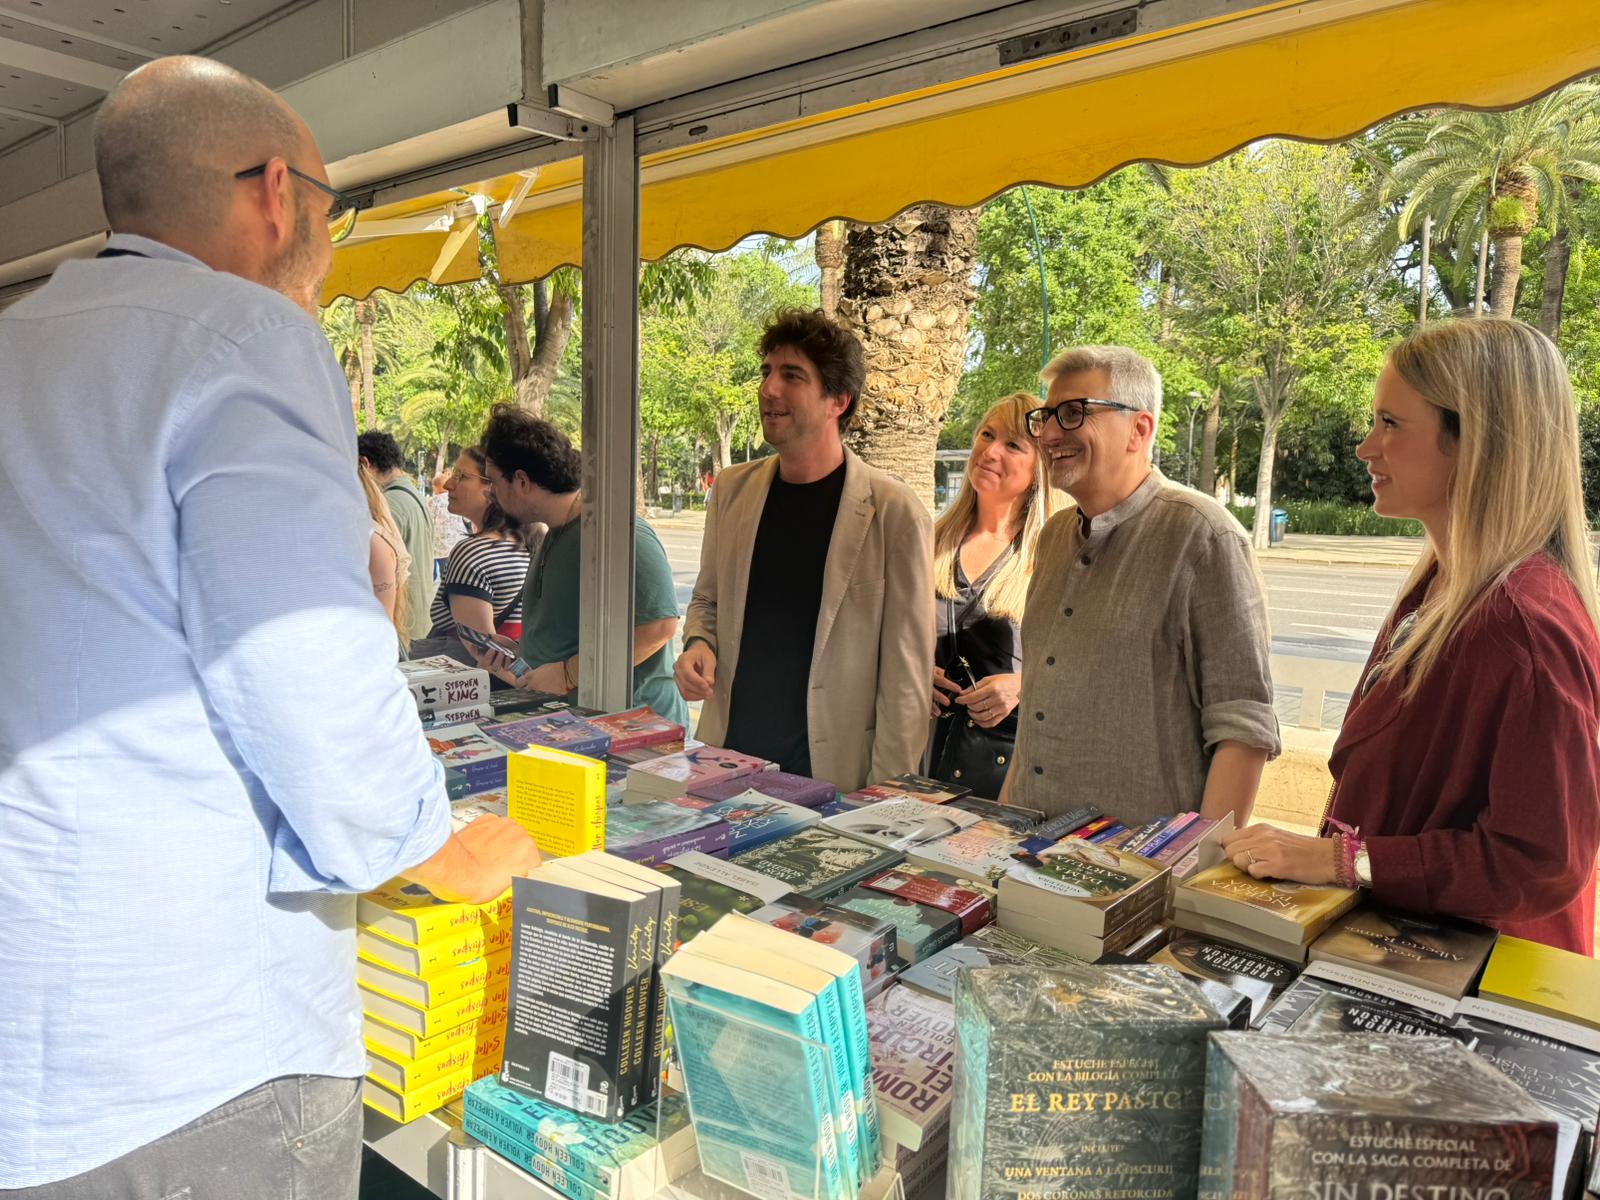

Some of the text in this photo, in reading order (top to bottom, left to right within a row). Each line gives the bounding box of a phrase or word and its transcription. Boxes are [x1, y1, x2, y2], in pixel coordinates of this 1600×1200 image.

[422, 685, 437, 704] IT
[445, 678, 479, 691] STEPHEN
[447, 689, 479, 704] KING
[445, 709, 480, 722] STEPHEN
[1056, 866, 1102, 884] DAMA
[1058, 856, 1127, 880] CARTUJA
[1062, 875, 1081, 884] LA
[1208, 879, 1298, 910] INGRATA
[1201, 946, 1284, 976] SANDERSON
[1400, 941, 1464, 961] Alberto
[1203, 955, 1269, 979] BRANDON
[633, 915, 657, 1066] COLLEEN HOOVER Verity
[654, 911, 678, 1058] COLLEEN HOOV Verity
[849, 975, 860, 1016] EMPEZAR
[1318, 966, 1446, 1006] BRANDON SANDERSON
[1340, 986, 1396, 1006] BRANDON
[620, 924, 642, 1076] COLLEEN HOOVER Verity
[825, 990, 839, 1036] EMPEZAR
[890, 1005, 955, 1038] OOVER
[1348, 1008, 1438, 1038] ANDERSON
[896, 1020, 954, 1045] COLLEEN
[1353, 1018, 1411, 1036] NDON
[856, 1024, 868, 1063] VOLVER
[868, 1023, 954, 1068] ÍRCUL
[1503, 1028, 1567, 1052] BRANDON
[834, 1044, 847, 1080] VOLVER
[1053, 1058, 1106, 1070] ESTUCHE
[921, 1065, 953, 1094] EL
[1028, 1069, 1182, 1082] CON LA BILOGÍA COMPLET
[871, 1066, 939, 1112] ROM
[468, 1096, 494, 1117] EMPEZAR
[1010, 1091, 1184, 1113] EL REY PASTO
[466, 1118, 492, 1139] EMPEZAR
[500, 1114, 522, 1136] VOLVER
[498, 1136, 520, 1159] VOLVER
[526, 1131, 553, 1154] HOOVER
[1350, 1136, 1476, 1152] ESTUCHE ESPECIAL
[524, 1154, 550, 1177] HOOVER
[554, 1145, 585, 1173] COLLEEN
[1312, 1152, 1511, 1171] CON LA SAGA COMPLETA DE
[552, 1166, 582, 1196] COLLEEN
[1004, 1167, 1032, 1177] UNA
[1036, 1166, 1092, 1176] VENTANA
[1096, 1166, 1103, 1176] A
[1018, 1191, 1042, 1200] DOS
[1044, 1190, 1102, 1200] CORONAS
[1308, 1182, 1510, 1200] SIN DESTINO
